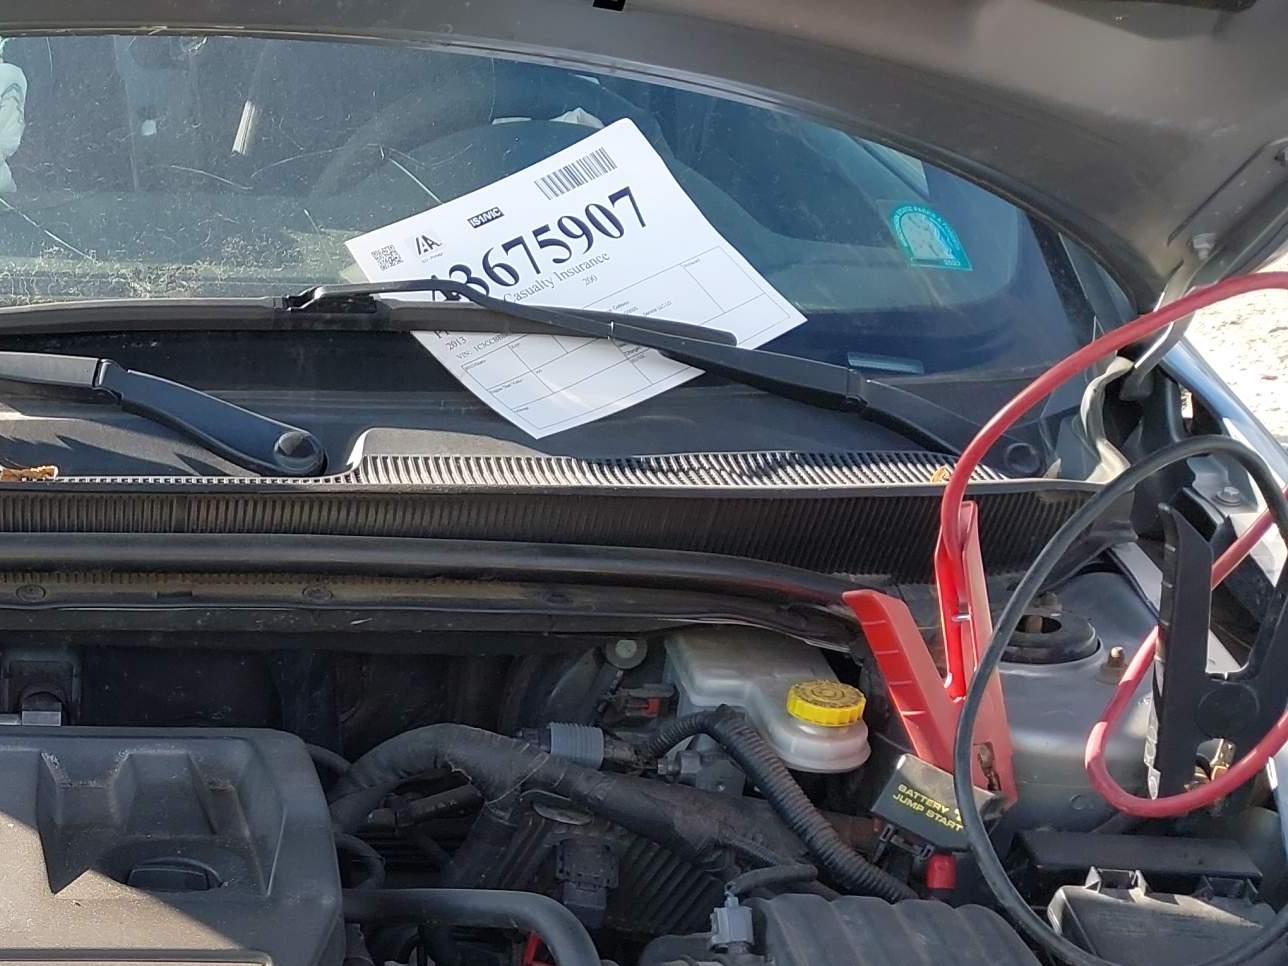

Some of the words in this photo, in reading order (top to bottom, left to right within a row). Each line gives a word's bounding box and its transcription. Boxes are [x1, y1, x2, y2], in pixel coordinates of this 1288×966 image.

[504, 275, 553, 303] Casualty
[554, 252, 610, 281] Insurance
[445, 336, 467, 351] 2013
[893, 793, 925, 813] JUMP
[926, 809, 964, 832] START
[898, 784, 950, 815] BATTERY
